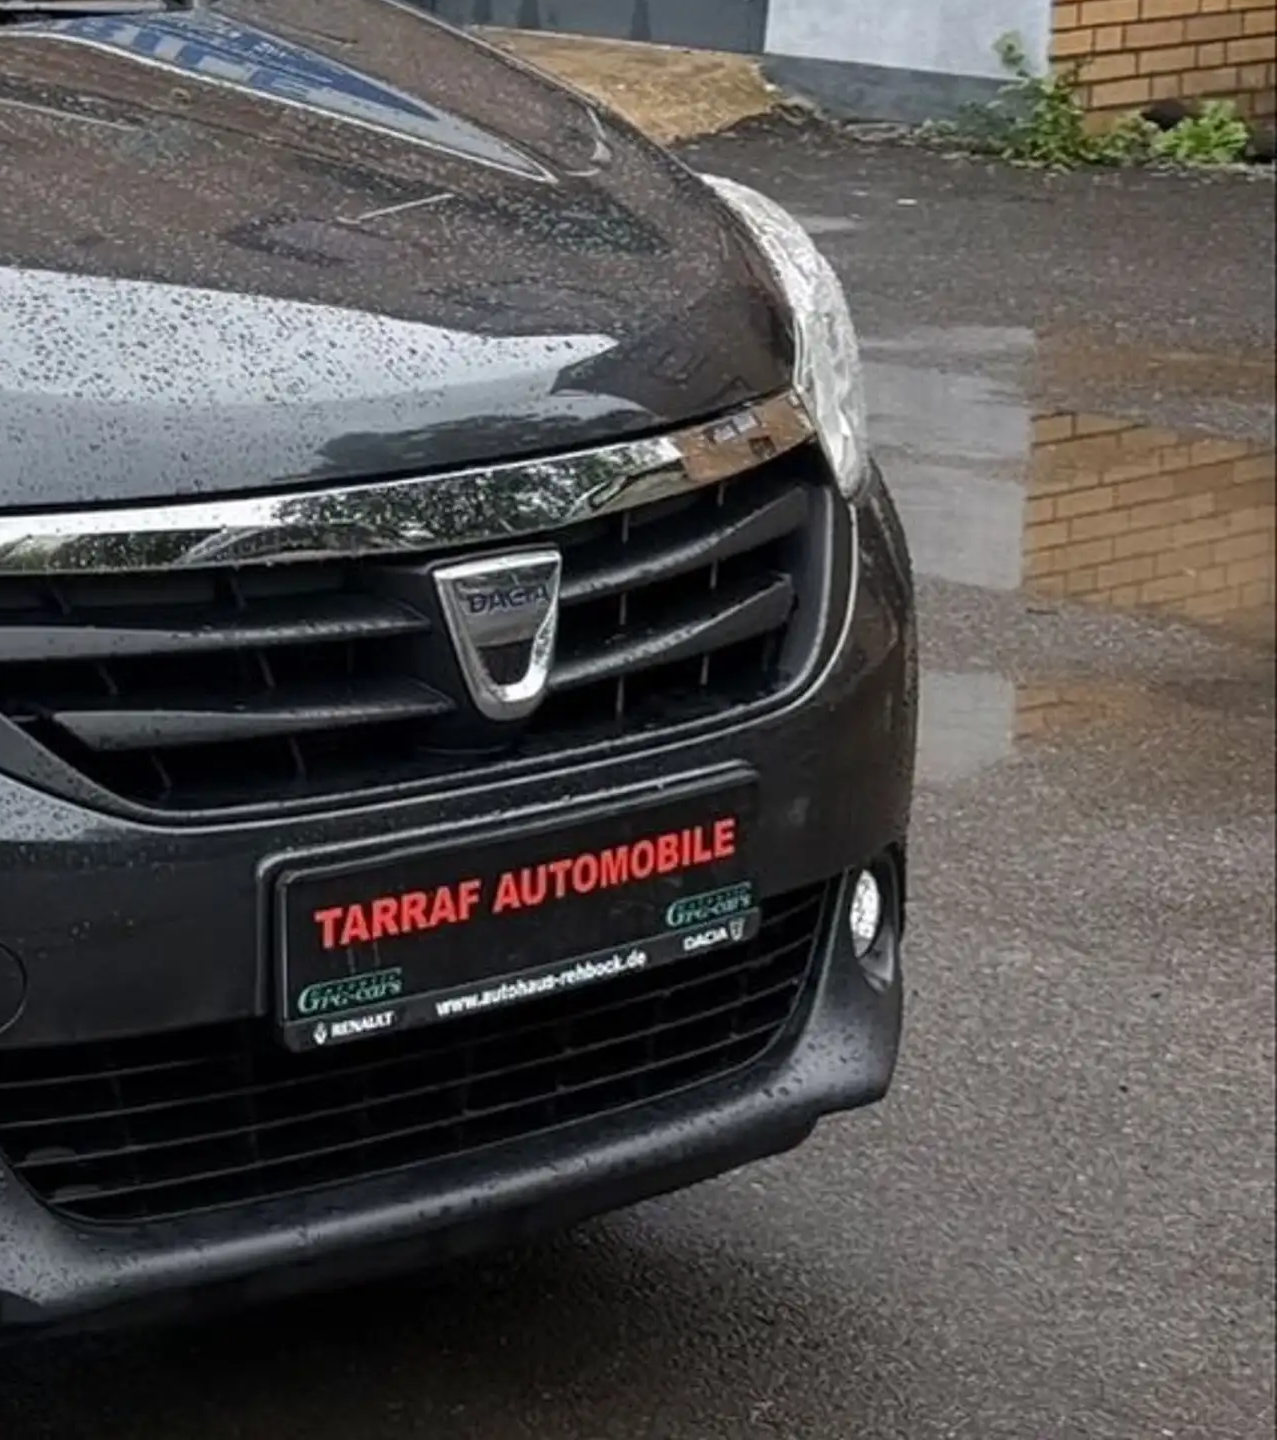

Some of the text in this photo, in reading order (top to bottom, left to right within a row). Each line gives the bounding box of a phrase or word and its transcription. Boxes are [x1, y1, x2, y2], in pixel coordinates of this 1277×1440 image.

[313, 818, 737, 950] TARRAF AUTOMOBILE
[683, 927, 728, 951] DACIA
[331, 1010, 395, 1038] RENAULT
